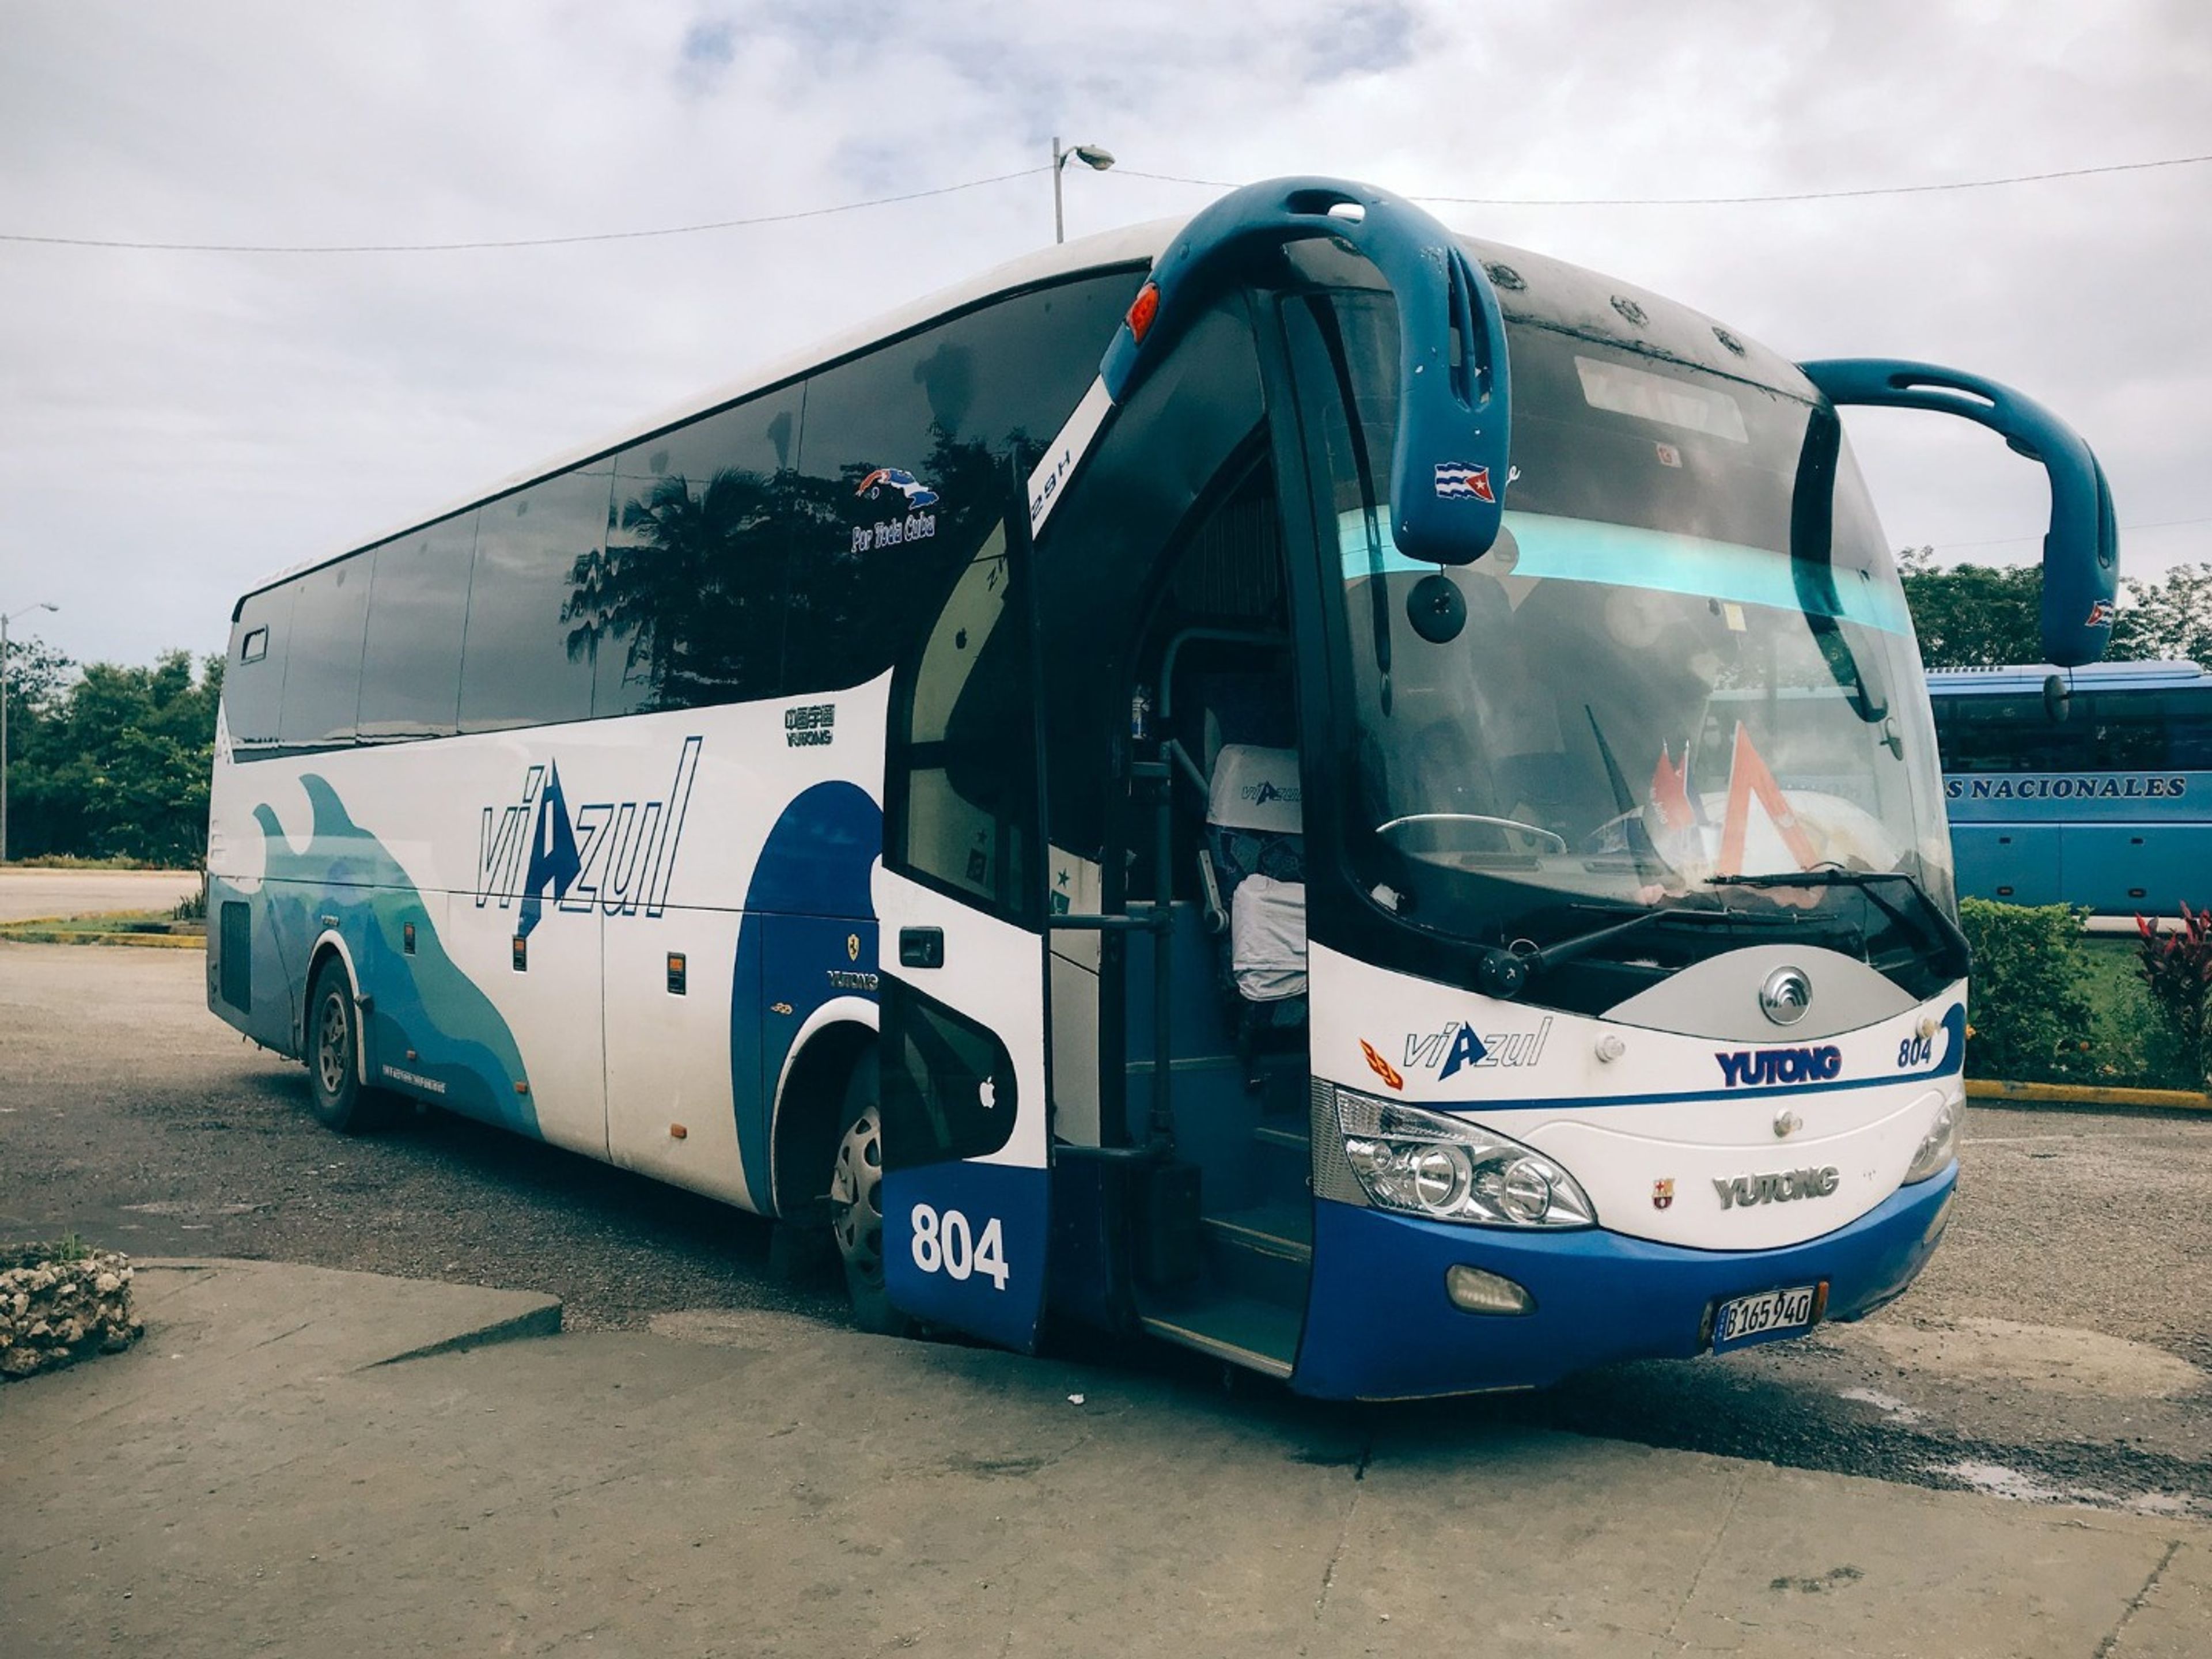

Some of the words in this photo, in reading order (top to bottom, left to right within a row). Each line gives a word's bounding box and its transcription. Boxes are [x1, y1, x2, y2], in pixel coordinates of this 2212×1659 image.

[851, 526, 873, 553] Por
[874, 517, 903, 548] Toda
[904, 511, 935, 541] Cuba
[786, 729, 834, 748] YUTONG
[1970, 778, 2186, 800] NACIONALES
[827, 970, 878, 990] YUTONG
[1715, 1045, 1842, 1086] YUTONG
[1897, 1037, 1931, 1067] 804
[1713, 1166, 1839, 1210] YUTONG
[911, 1203, 1009, 1290] 804
